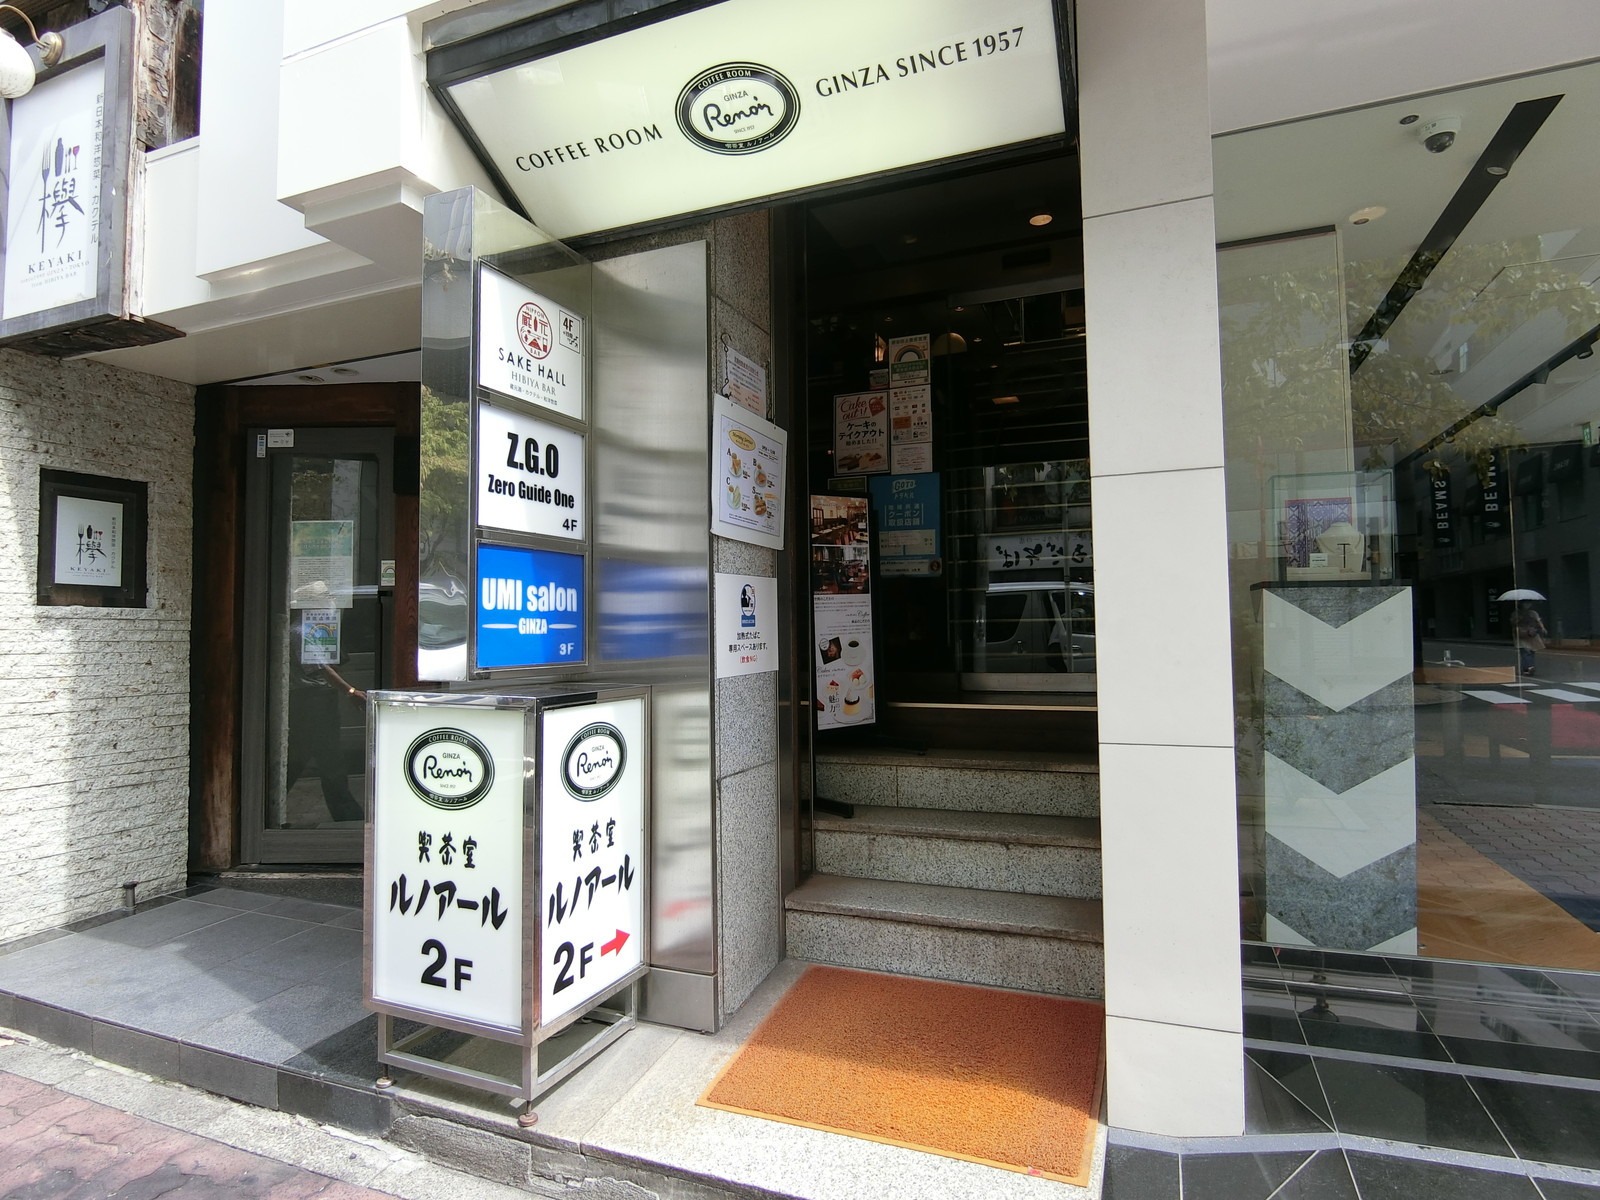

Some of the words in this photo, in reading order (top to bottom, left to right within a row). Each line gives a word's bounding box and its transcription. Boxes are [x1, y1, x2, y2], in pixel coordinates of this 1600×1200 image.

[698, 73, 724, 90] COFFEE
[726, 69, 751, 77] ROOM
[516, 142, 590, 173] COFFEE
[594, 124, 664, 153] ROOM
[816, 66, 890, 98] GINZA
[895, 41, 968, 79] SINCE
[973, 26, 1025, 57] 1957
[723, 90, 749, 102] GINZA
[703, 96, 774, 132] Renoir
[28, 250, 82, 274] KEYAKI
[563, 317, 574, 332] 4F
[498, 347, 532, 372] SAKE
[538, 365, 566, 387] HALL
[511, 371, 539, 389] HIBIYA
[542, 383, 557, 396] BAR
[838, 429, 885, 440] テイクアウト
[846, 421, 877, 431] ケーキの
[506, 432, 559, 479] Z.G.O
[487, 474, 515, 497] Zero
[518, 481, 551, 504] Guide
[554, 488, 575, 509] One
[562, 518, 577, 532] 4F
[888, 510, 920, 518] クーポン
[482, 577, 522, 611] UMI
[526, 582, 577, 613] salon
[518, 617, 547, 635] GINZA
[736, 631, 761, 641] 加熱式たばこ
[559, 642, 574, 656] 3F
[429, 734, 449, 743] COFFEE
[450, 734, 468, 745] ROOM
[423, 754, 473, 783] Renoir
[418, 830, 478, 869] 喫茶室
[572, 817, 616, 862] 喫茶室
[390, 873, 508, 931] ルノアール
[547, 854, 635, 929] ルノアール
[421, 938, 473, 991] 2F
[553, 941, 594, 996] 2F
